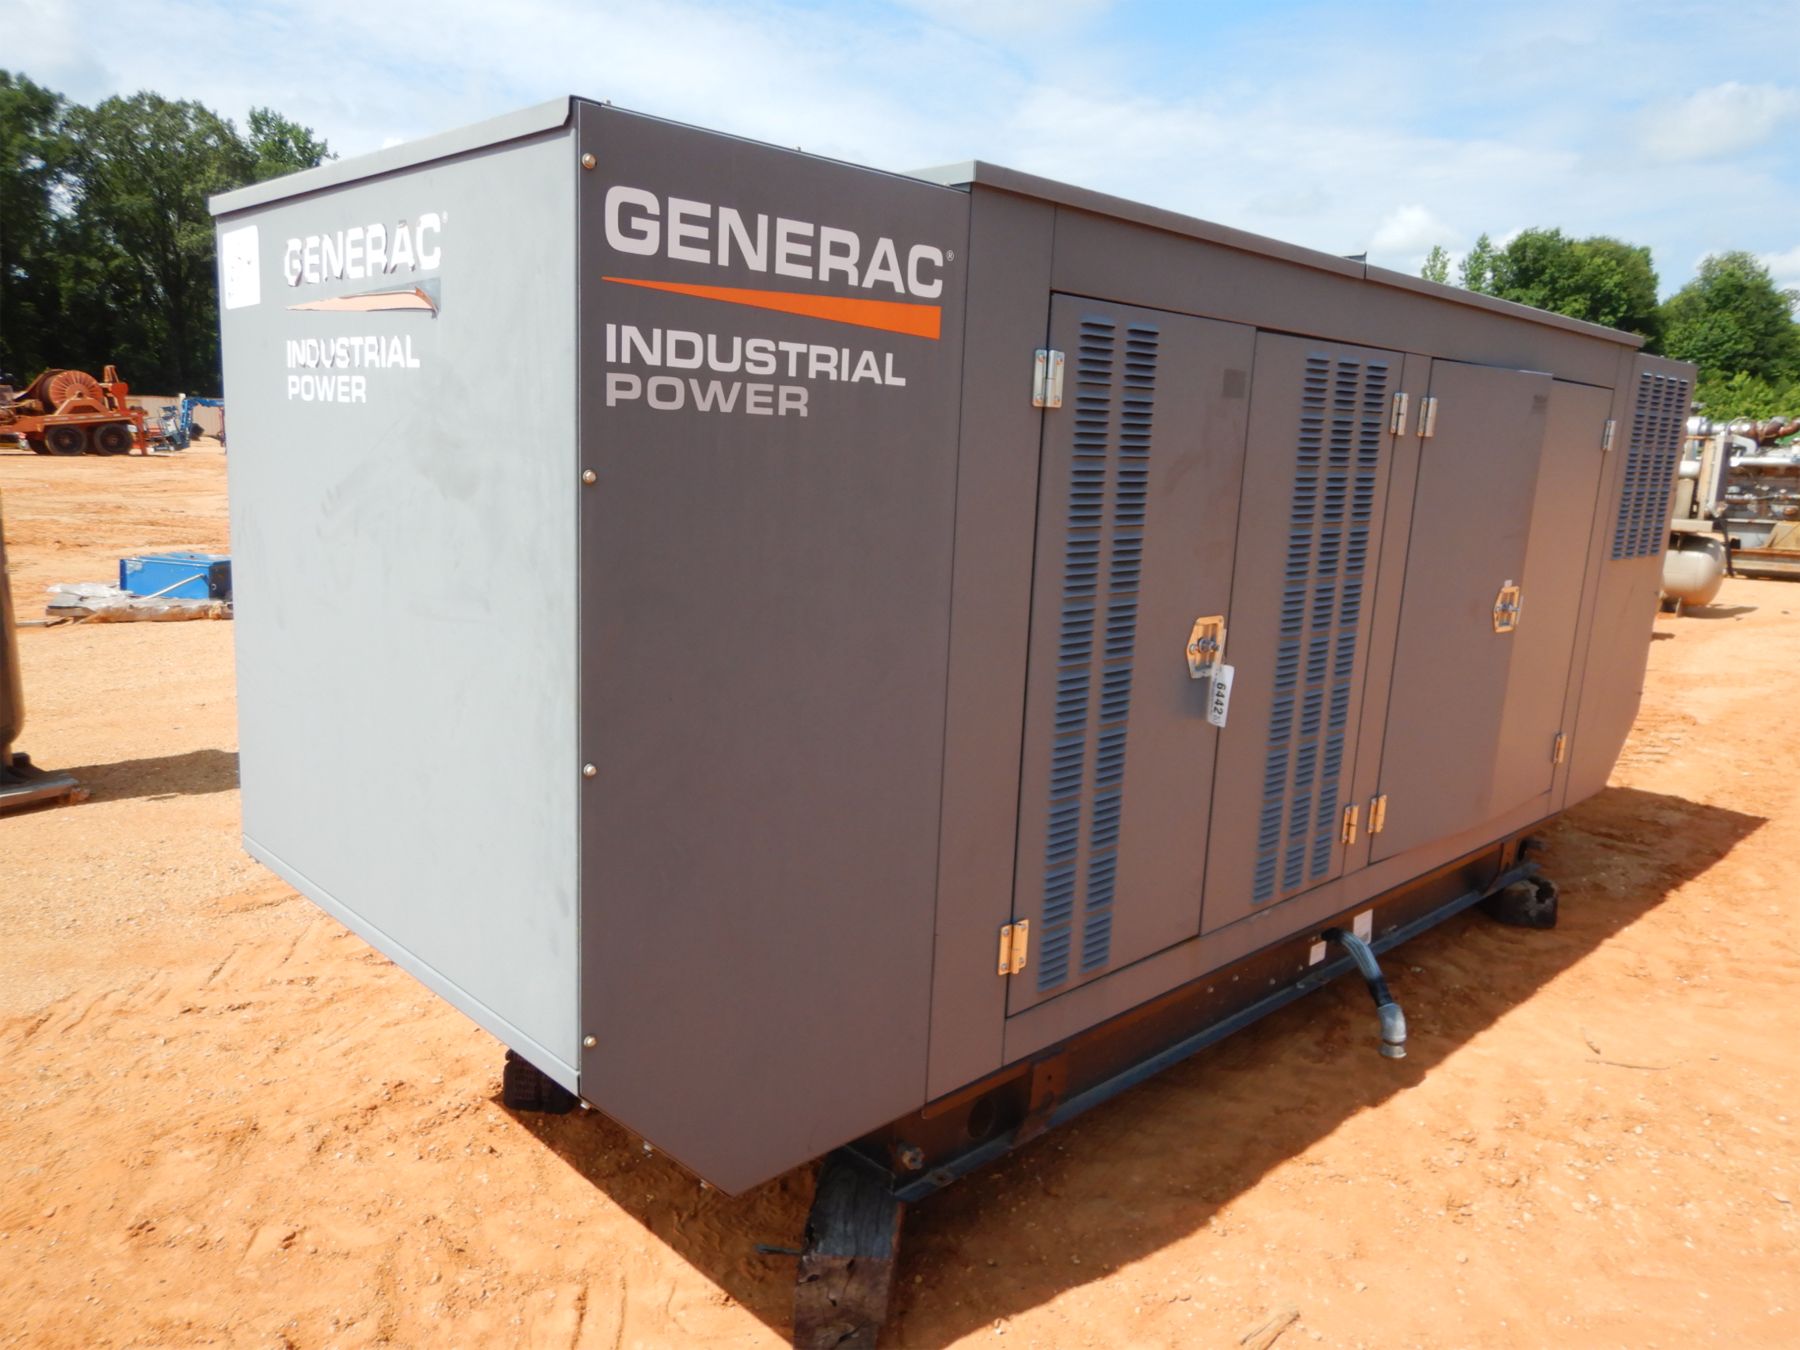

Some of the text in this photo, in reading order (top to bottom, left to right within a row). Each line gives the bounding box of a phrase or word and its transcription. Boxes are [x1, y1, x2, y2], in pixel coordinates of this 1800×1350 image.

[284, 212, 442, 288] GENERAC
[604, 185, 943, 299] GENERAC
[286, 335, 420, 368] INDUSTRIAL
[606, 323, 906, 386] INDUSTRIAL
[287, 374, 367, 403] POWER
[606, 372, 809, 417] POWER
[1213, 682, 1226, 716] 6442
